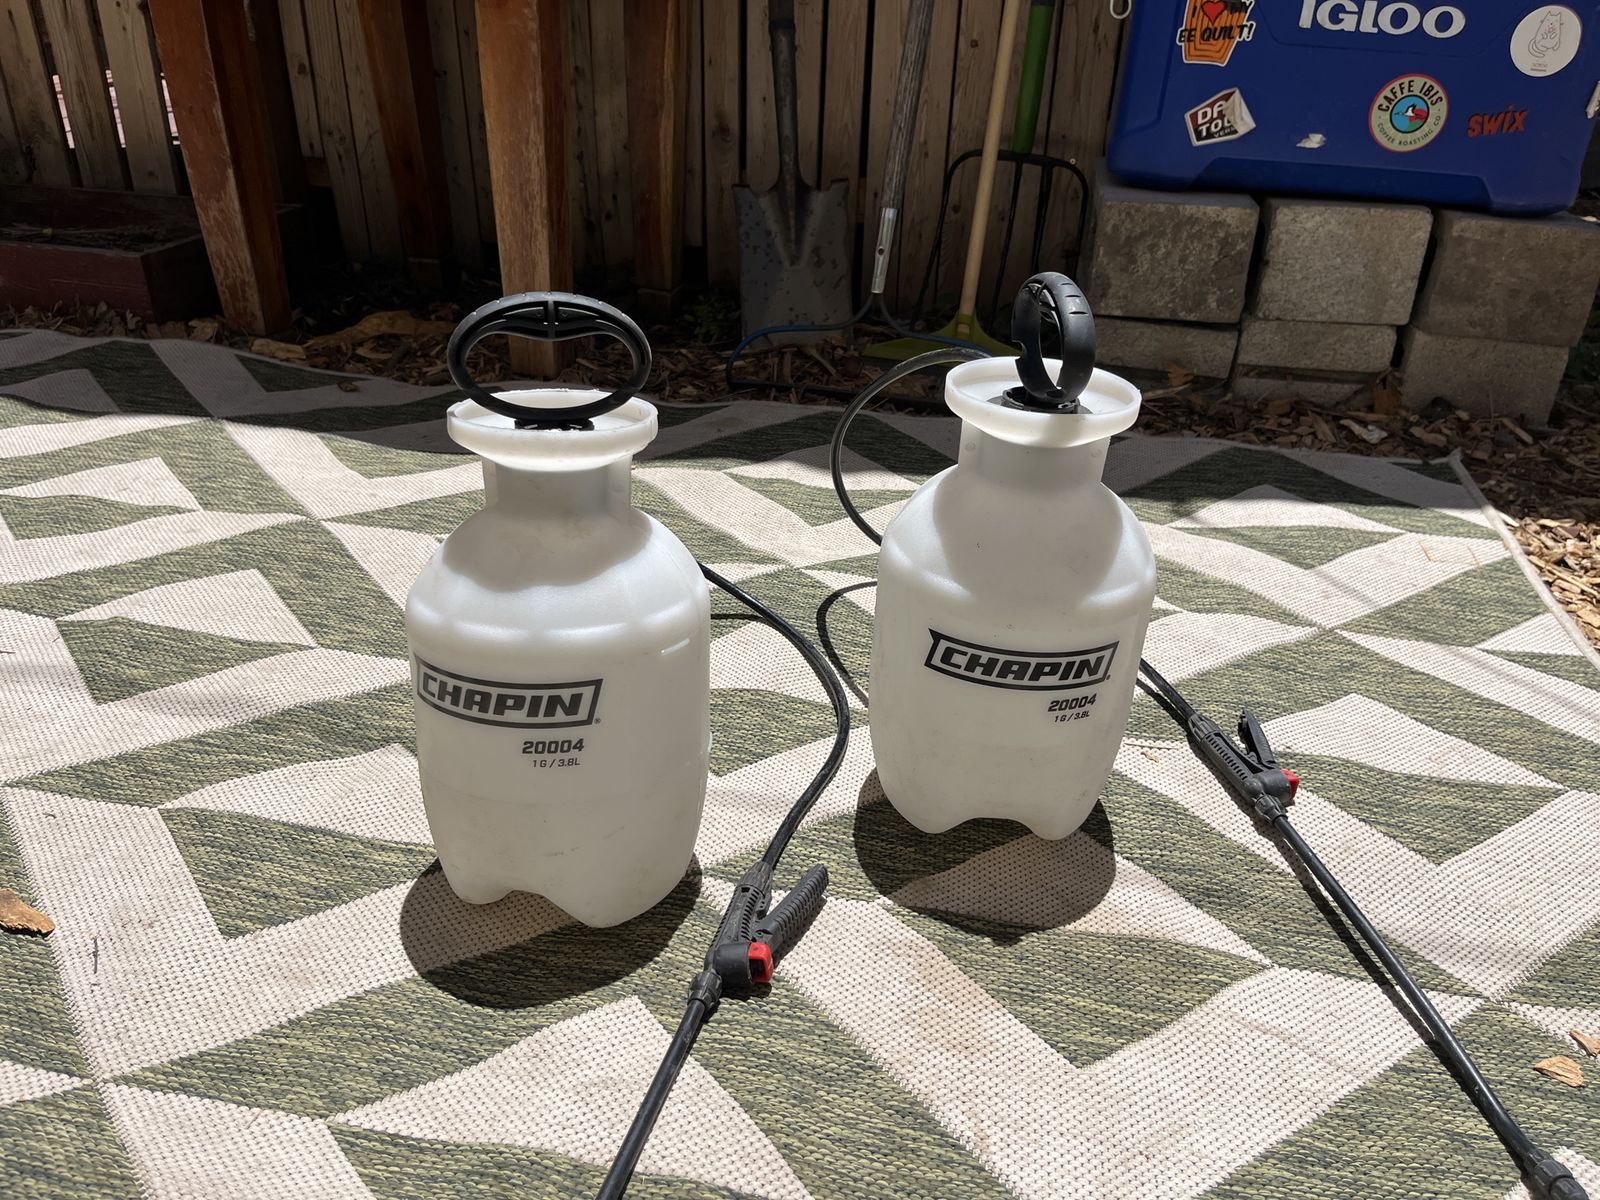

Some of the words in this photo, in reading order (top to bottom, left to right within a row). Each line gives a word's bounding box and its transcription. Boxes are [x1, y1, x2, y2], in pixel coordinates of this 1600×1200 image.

[1201, 23, 1254, 42] QUILT!
[1299, 0, 1466, 39] IGLOO
[1377, 79, 1414, 112] CAFFE
[1419, 81, 1443, 106] IBIS
[1377, 122, 1395, 144] COFFEE
[1398, 128, 1434, 146] ROASTING
[939, 646, 1105, 682] CHAPIN
[422, 671, 584, 718] CHAPIN
[1047, 693, 1097, 712] 20004
[522, 738, 585, 755] 20004
